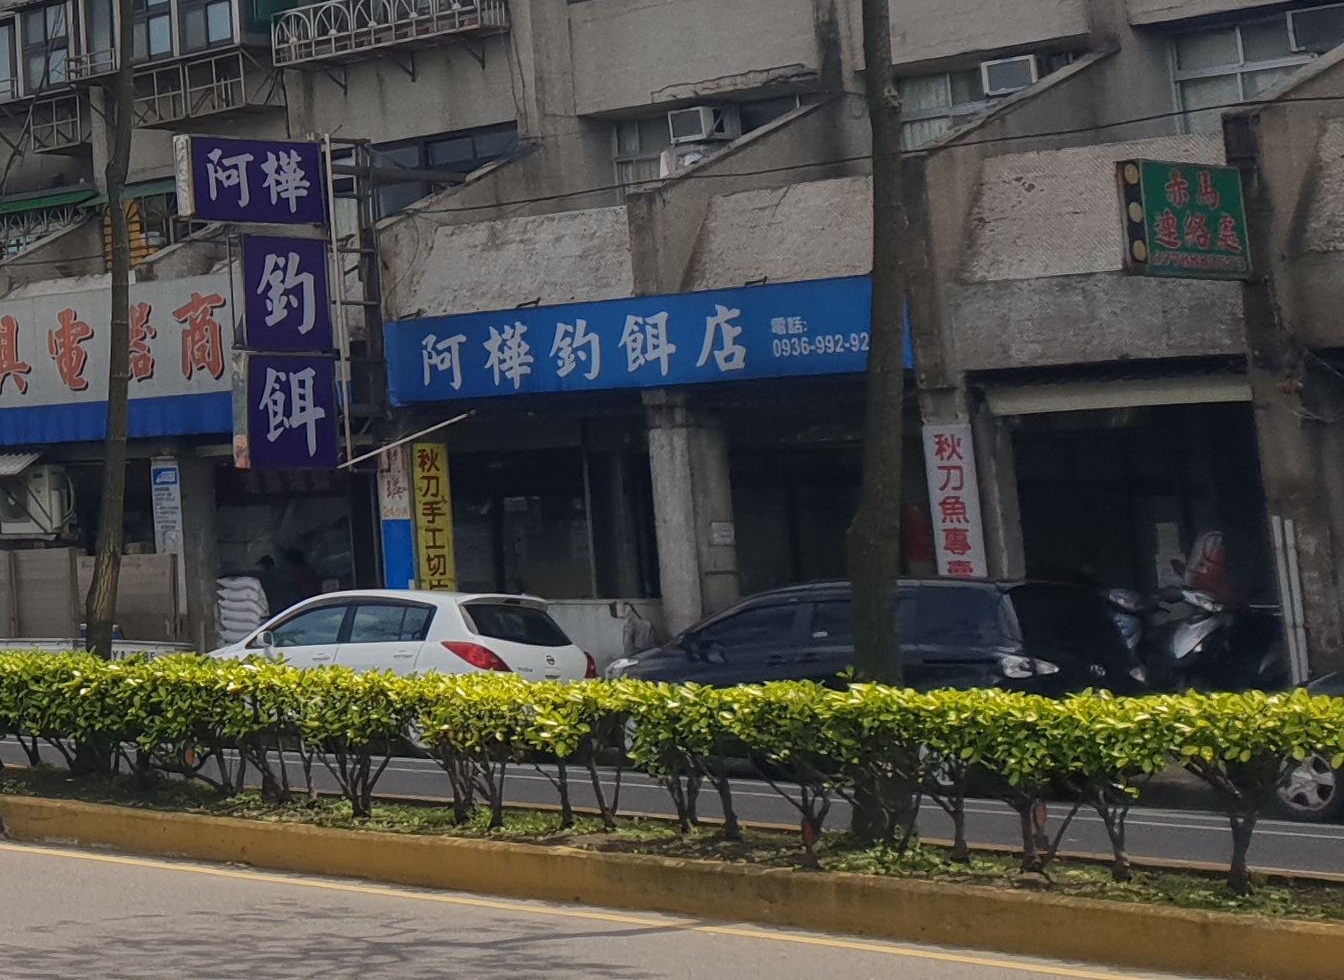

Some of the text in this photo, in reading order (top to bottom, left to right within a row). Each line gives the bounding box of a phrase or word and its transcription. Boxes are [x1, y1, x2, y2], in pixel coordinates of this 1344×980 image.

[206, 147, 310, 214] 阿樺
[255, 251, 327, 458] 釣餌
[420, 303, 747, 391] 阿樺釣餌店
[772, 331, 870, 358] 0936-992-92
